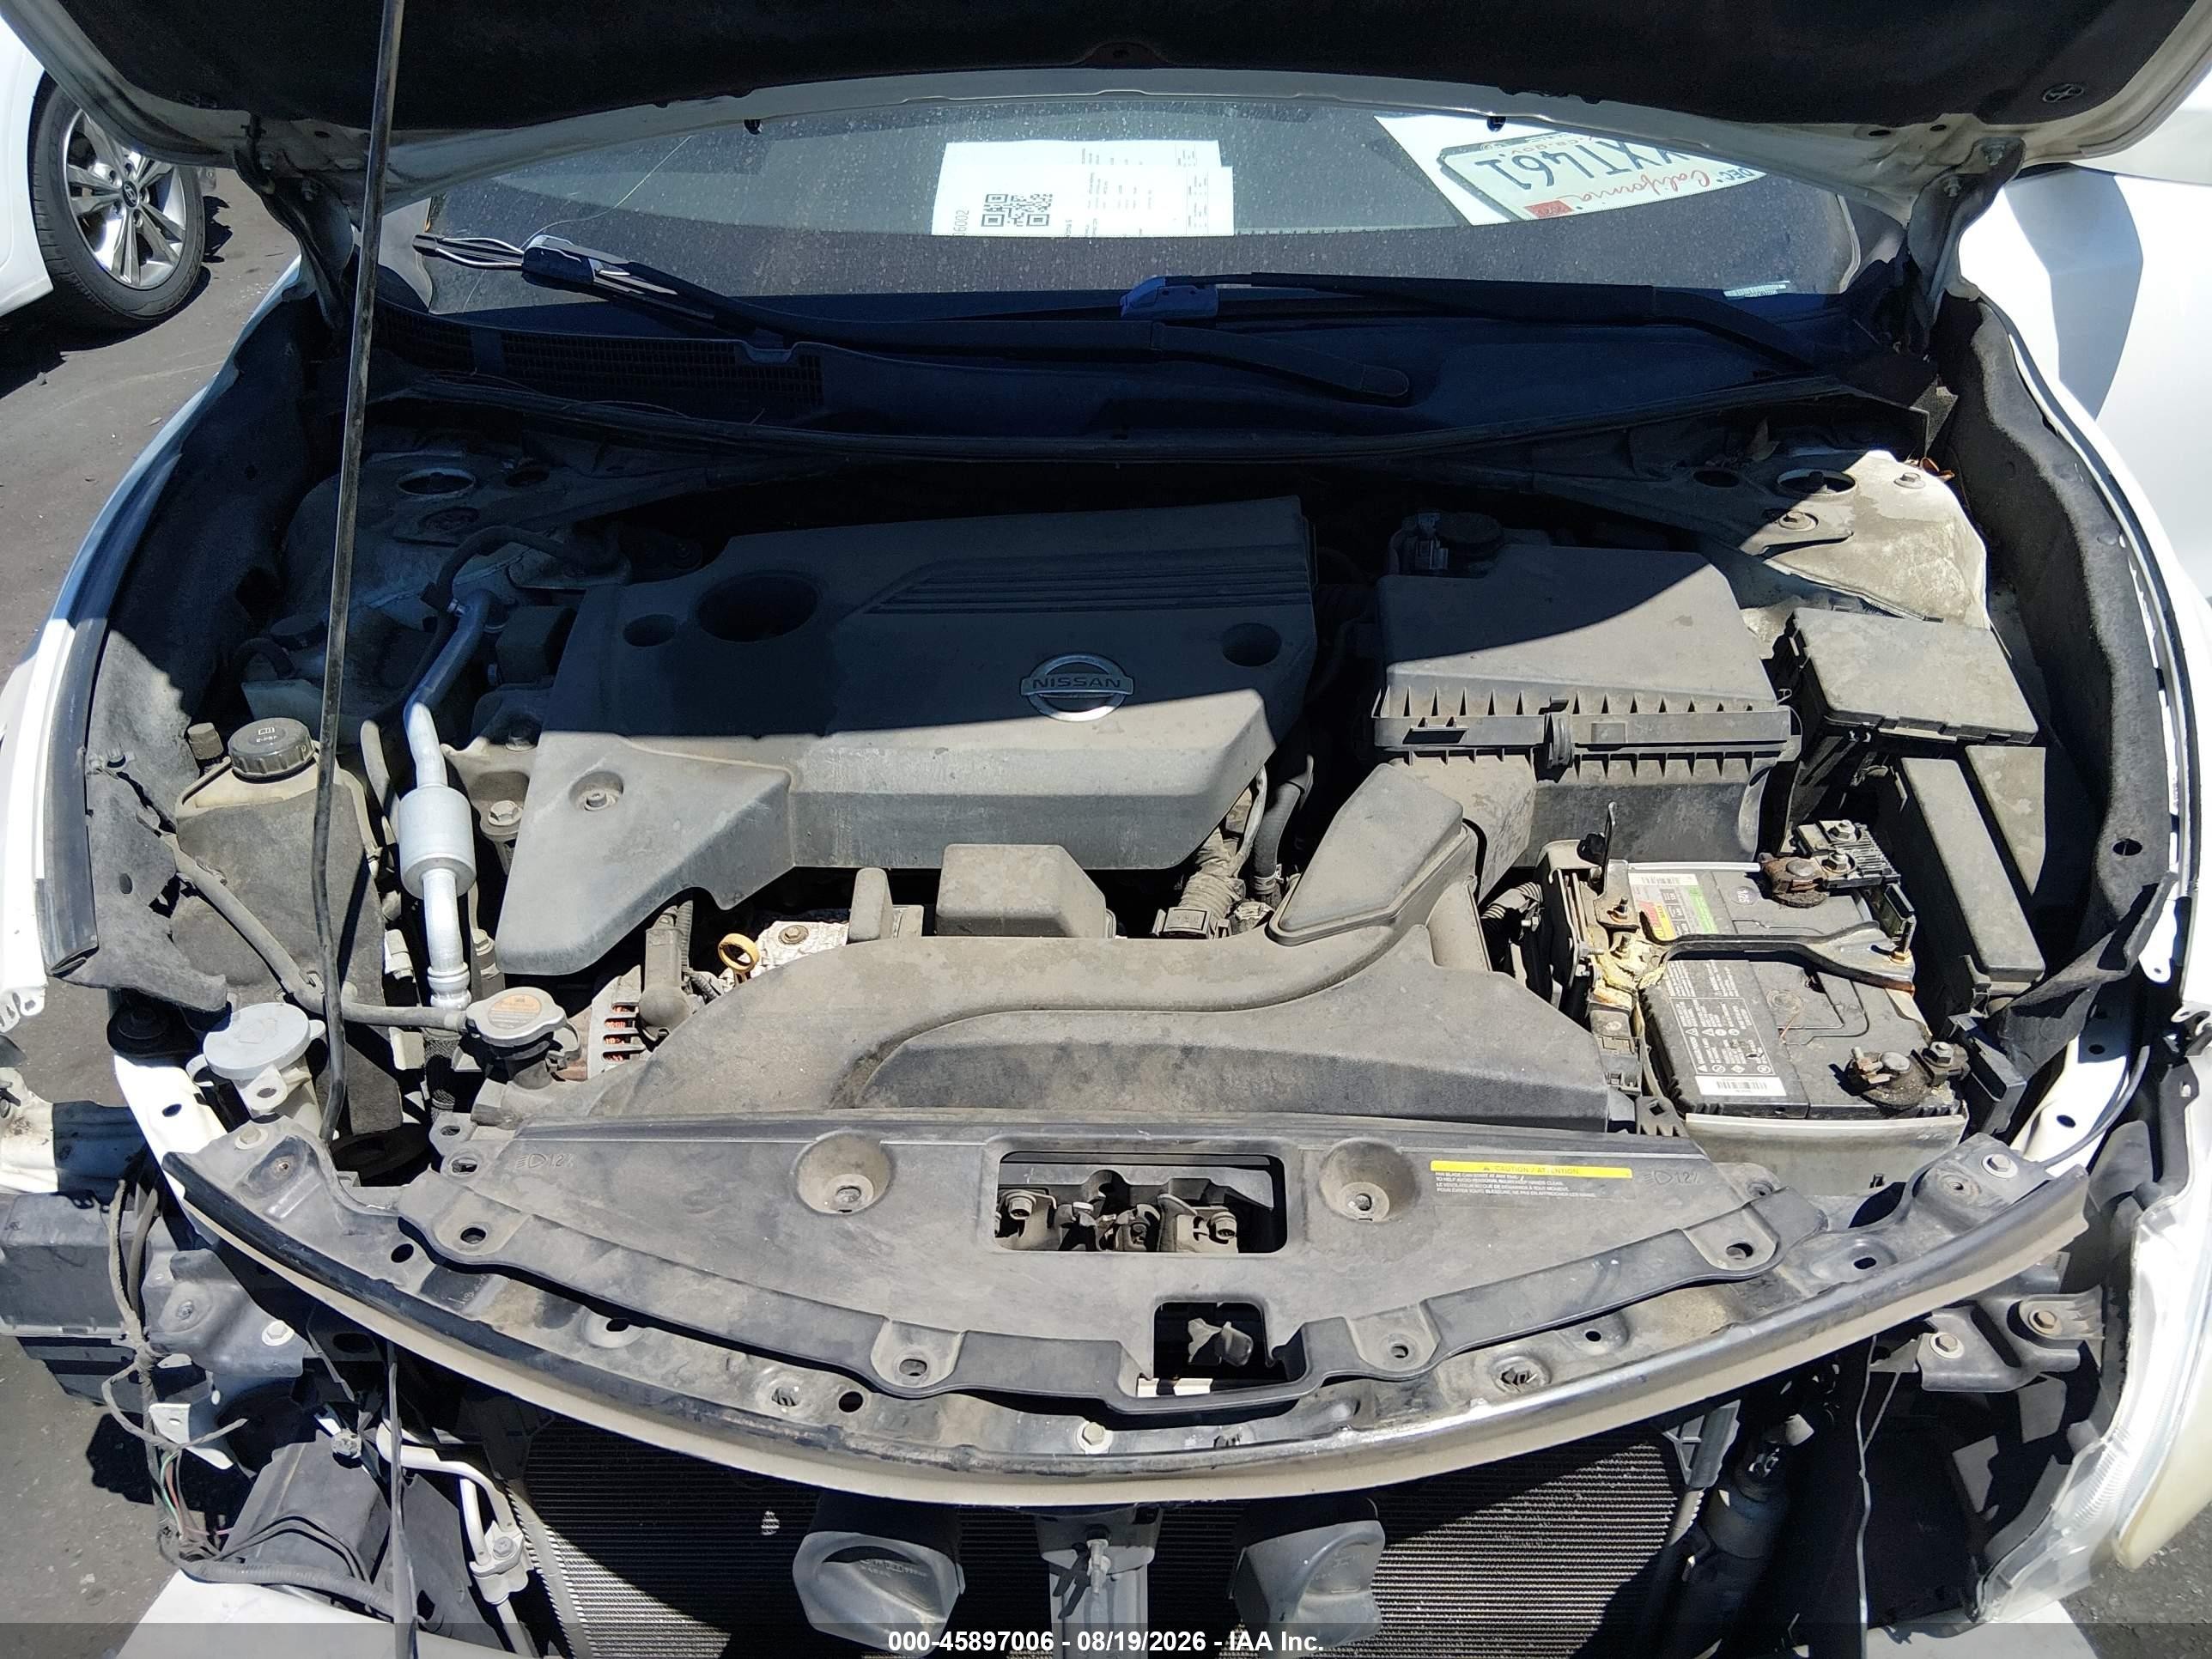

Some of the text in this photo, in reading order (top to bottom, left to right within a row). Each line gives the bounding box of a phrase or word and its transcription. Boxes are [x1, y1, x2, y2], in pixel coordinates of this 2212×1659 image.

[1722, 166, 1755, 182] DEC
[1567, 168, 1711, 204] California
[1032, 677, 1121, 690] NISSAN
